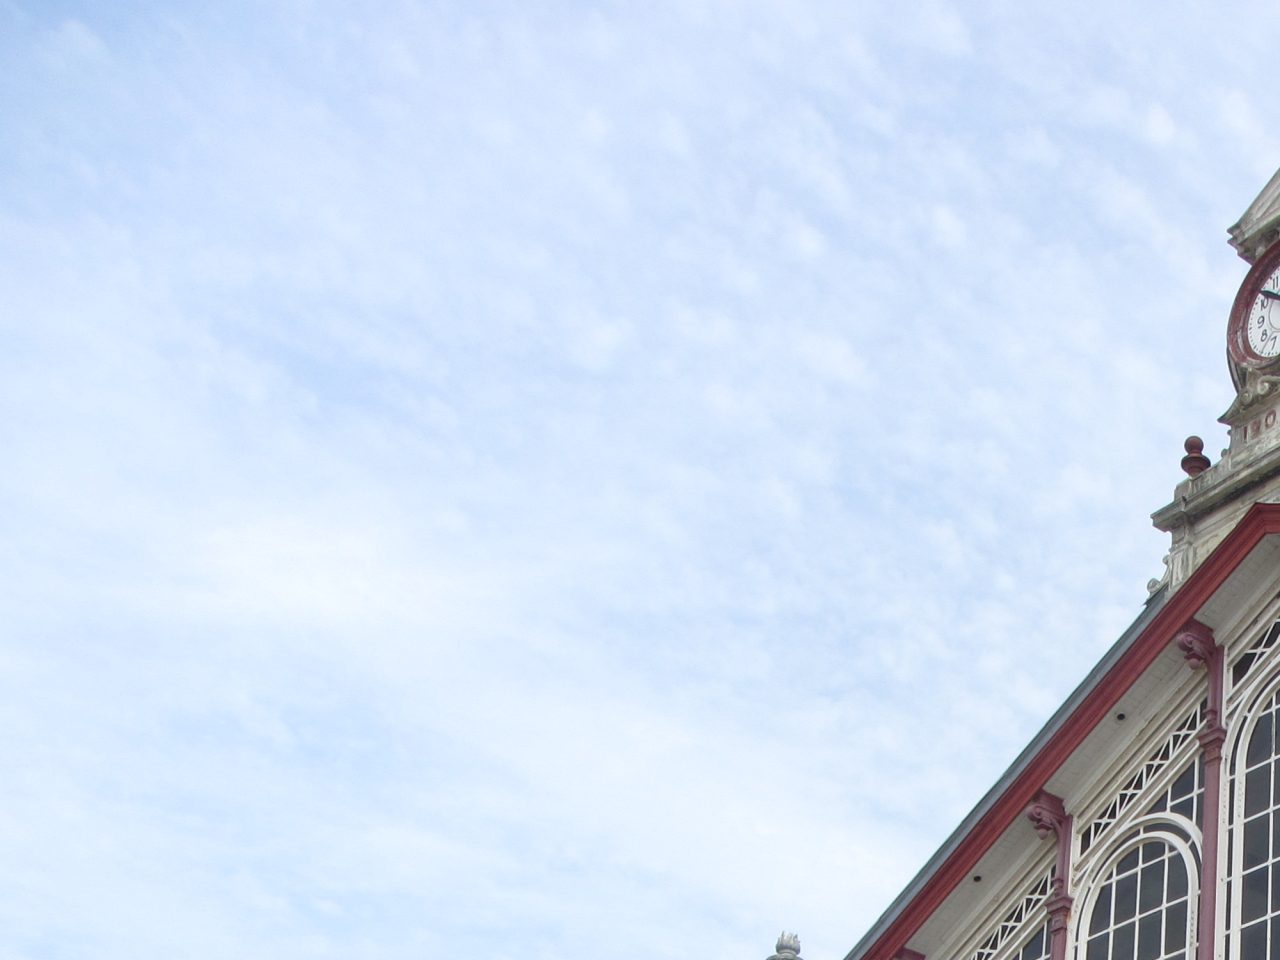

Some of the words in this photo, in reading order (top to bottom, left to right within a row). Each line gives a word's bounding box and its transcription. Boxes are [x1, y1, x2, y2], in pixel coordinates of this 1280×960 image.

[1272, 276, 1279, 290] 11
[1257, 315, 1265, 329] 9
[1260, 329, 1268, 342] 8
[1270, 335, 1277, 350] 7
